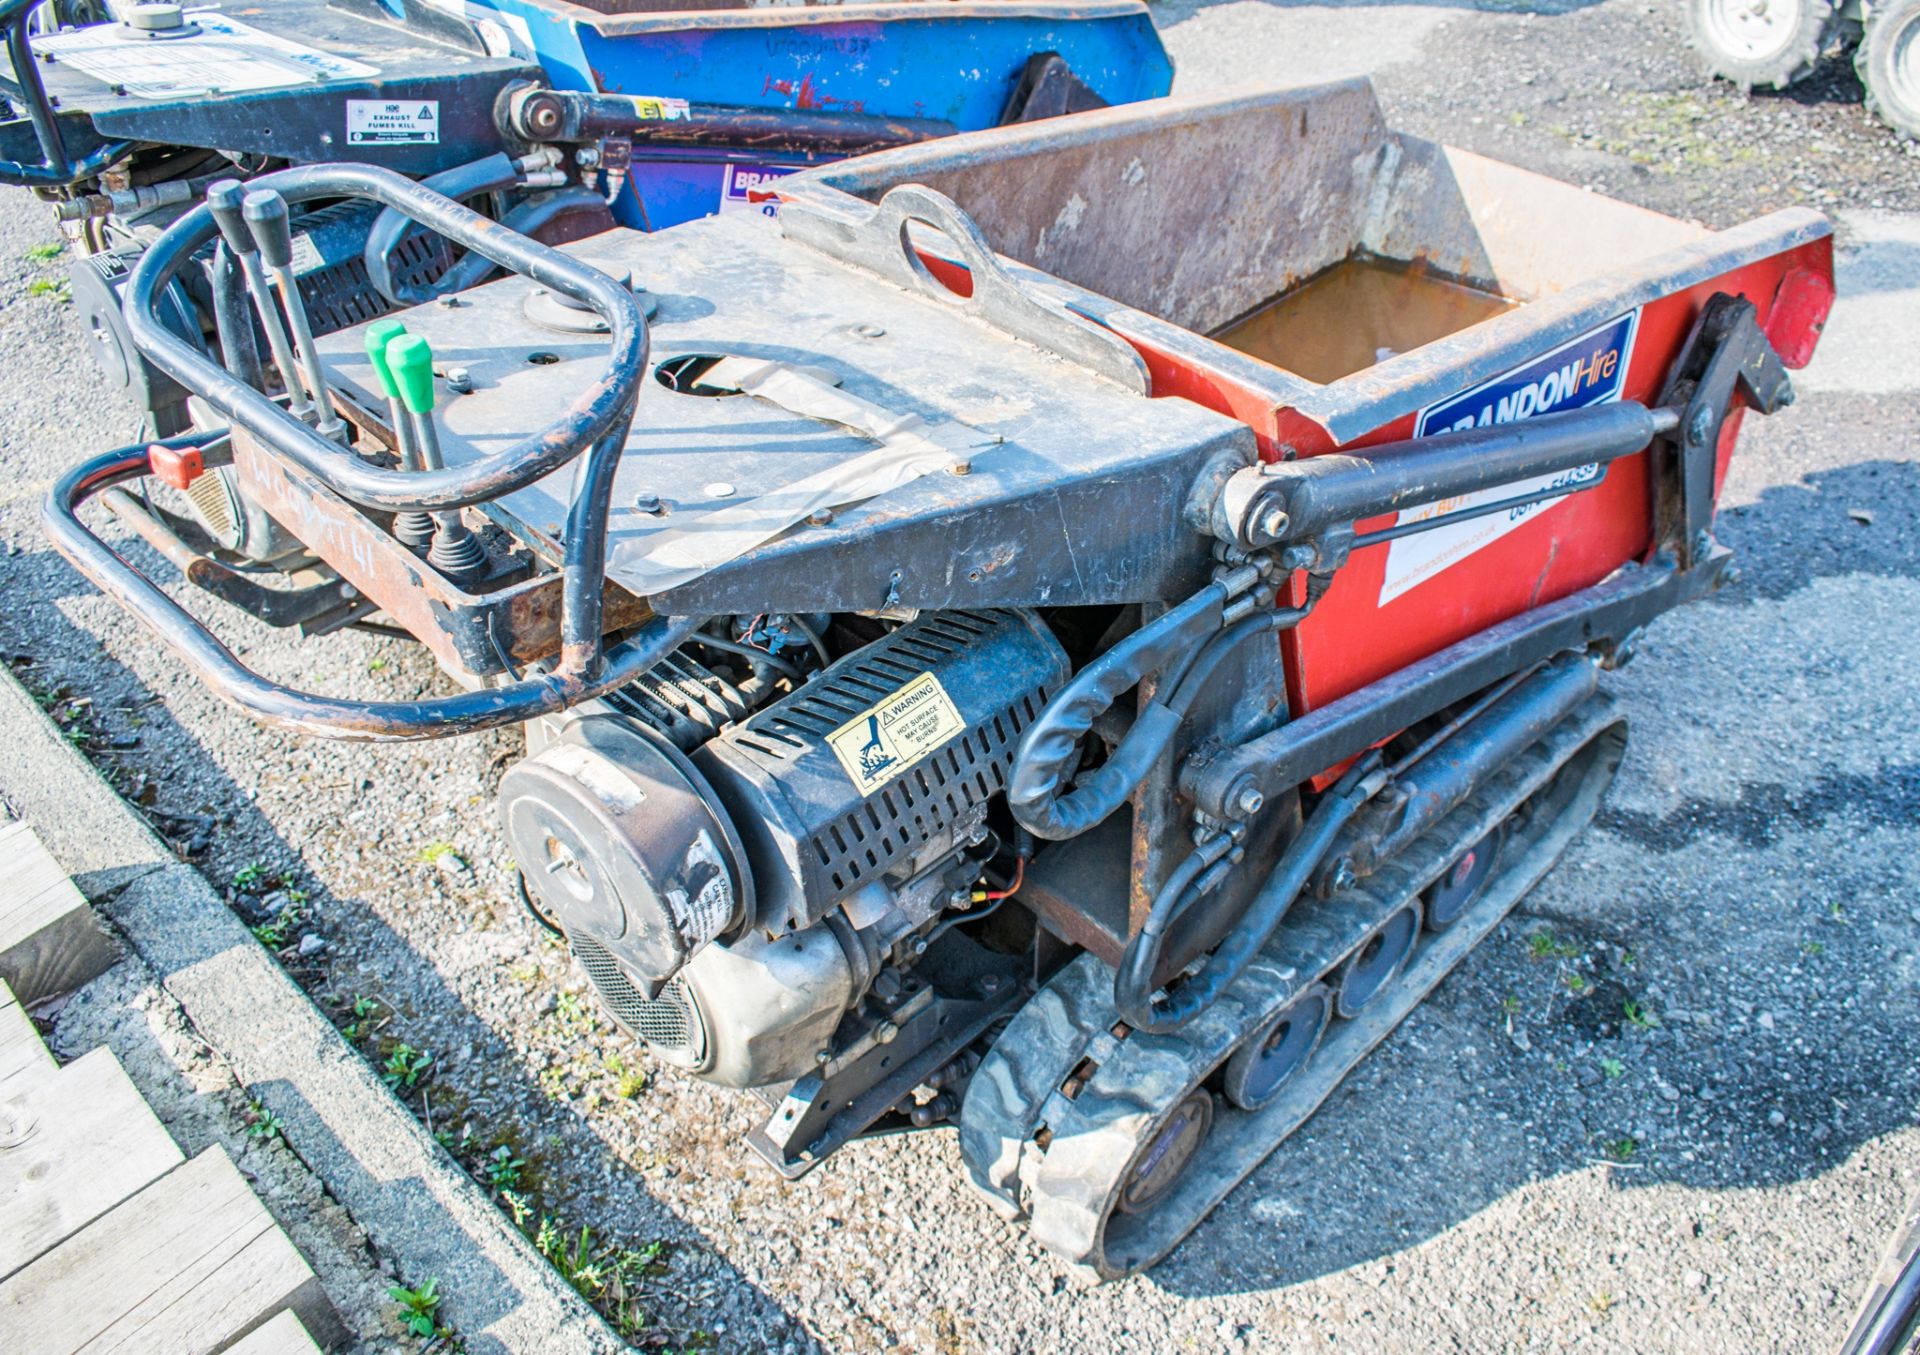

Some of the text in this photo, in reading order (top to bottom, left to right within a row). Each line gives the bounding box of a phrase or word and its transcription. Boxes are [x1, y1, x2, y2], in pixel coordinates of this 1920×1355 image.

[891, 684, 934, 716] WARNING
[897, 704, 939, 736] HOT SURFACE
[904, 714, 939, 740] MAY CAUSE
[915, 726, 938, 743] BURNS
